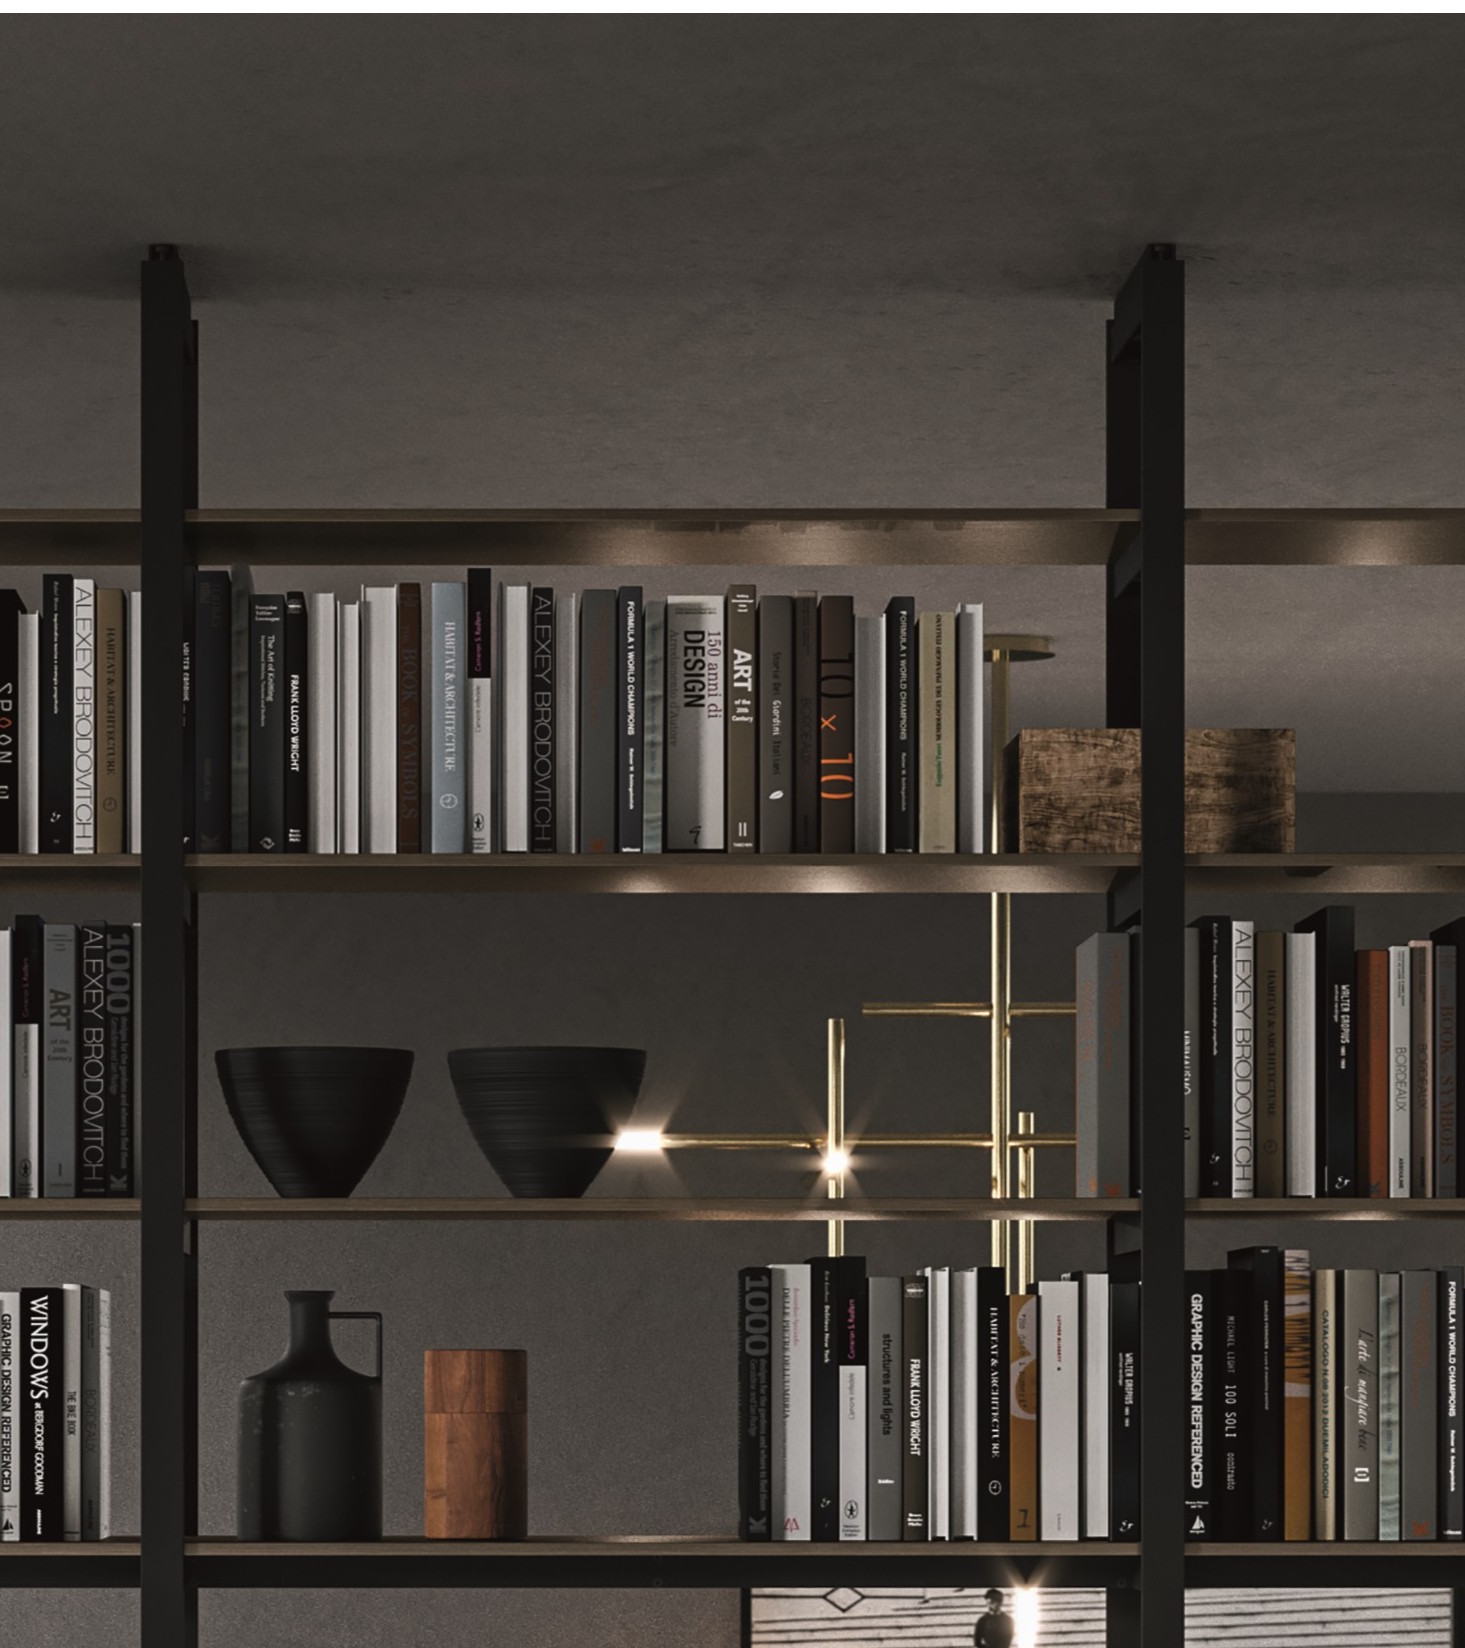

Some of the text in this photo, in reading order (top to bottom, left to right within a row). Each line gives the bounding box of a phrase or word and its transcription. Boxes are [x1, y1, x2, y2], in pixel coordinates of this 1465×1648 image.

[267, 635, 275, 648] The
[267, 650, 275, 665] Art
[627, 601, 635, 643] FORMULA
[267, 674, 275, 701] Knitting
[444, 622, 455, 771] HABITAT & ARCHITECTURE
[627, 651, 635, 683] WORLD
[684, 630, 705, 708] DESIGN
[707, 630, 721, 719] 150 anni di
[76, 587, 92, 838] ALEXEY BRODOVITCH
[627, 685, 635, 735] CHAMPIONS
[820, 652, 852, 800] 10 x 10
[1235, 929, 1252, 1180] ALEXEY BRODOVITCH
[30, 1295, 49, 1399] WINDOWS
[881, 1334, 892, 1436] structures and lights
[34, 1410, 44, 1452] BERGDORF
[910, 1359, 920, 1456] FRANK LLOYD WRIGHT
[34, 1453, 44, 1495] GOODMAN
